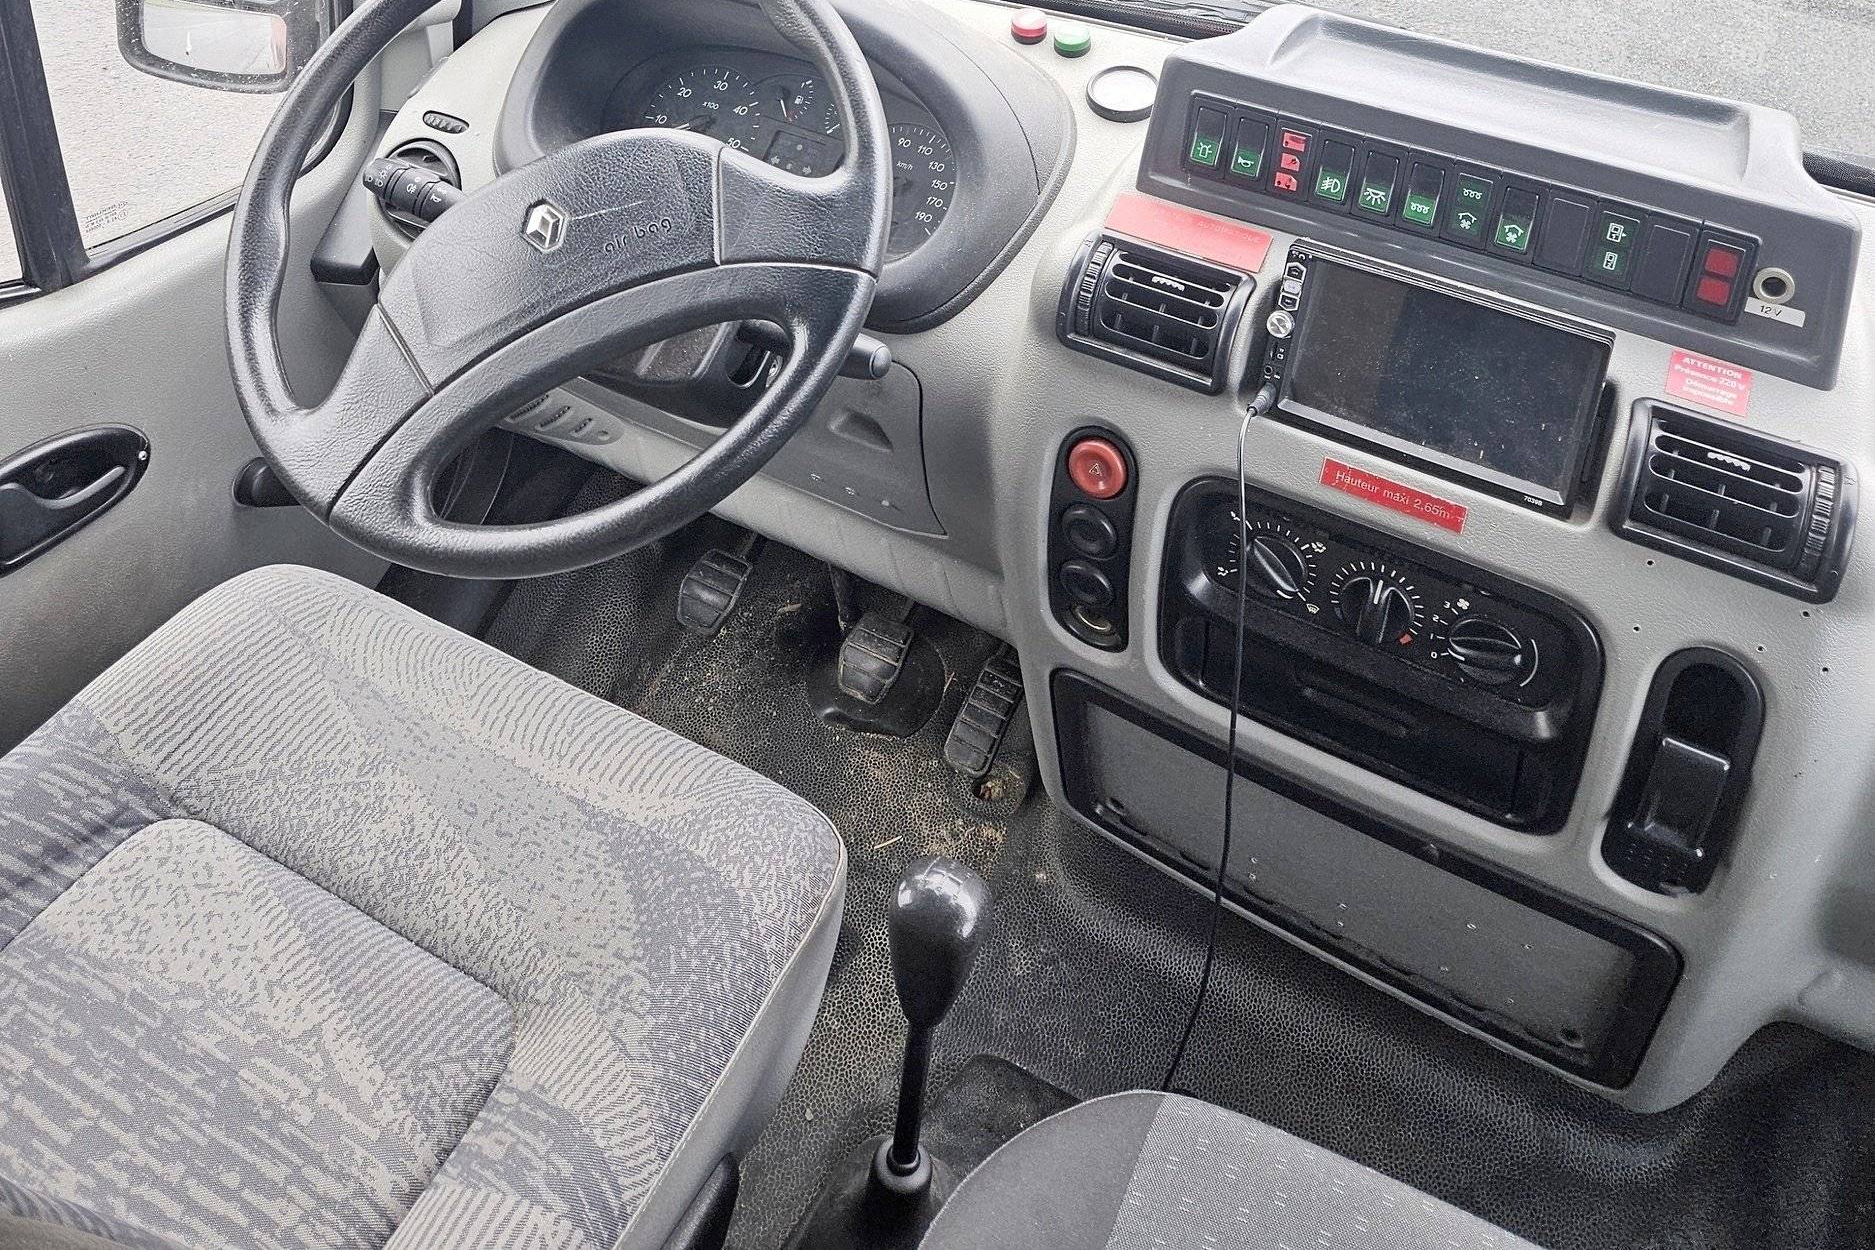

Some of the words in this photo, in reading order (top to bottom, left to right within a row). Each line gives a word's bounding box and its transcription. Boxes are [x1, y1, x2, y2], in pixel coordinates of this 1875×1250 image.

[713, 80, 729, 91] 30
[677, 87, 692, 98] 20
[702, 101, 720, 110] x100
[732, 105, 749, 116] 40
[654, 113, 668, 125] 10
[726, 137, 741, 149] 50
[898, 137, 911, 148] 90
[917, 145, 933, 156] 110
[896, 160, 914, 171] km/h
[928, 160, 945, 172] 130
[931, 179, 948, 191] 150
[926, 196, 944, 208] 170
[914, 211, 933, 223] 190
[604, 234, 628, 253] air
[633, 217, 672, 240] bag
[1760, 305, 1772, 315] 12
[1682, 356, 1743, 380] ATTENTION
[1719, 376, 1738, 390] 220
[1335, 470, 1380, 494] Hauteur
[1382, 488, 1410, 506] maxi
[1443, 600, 1451, 609] 3
[1432, 614, 1440, 623] 2
